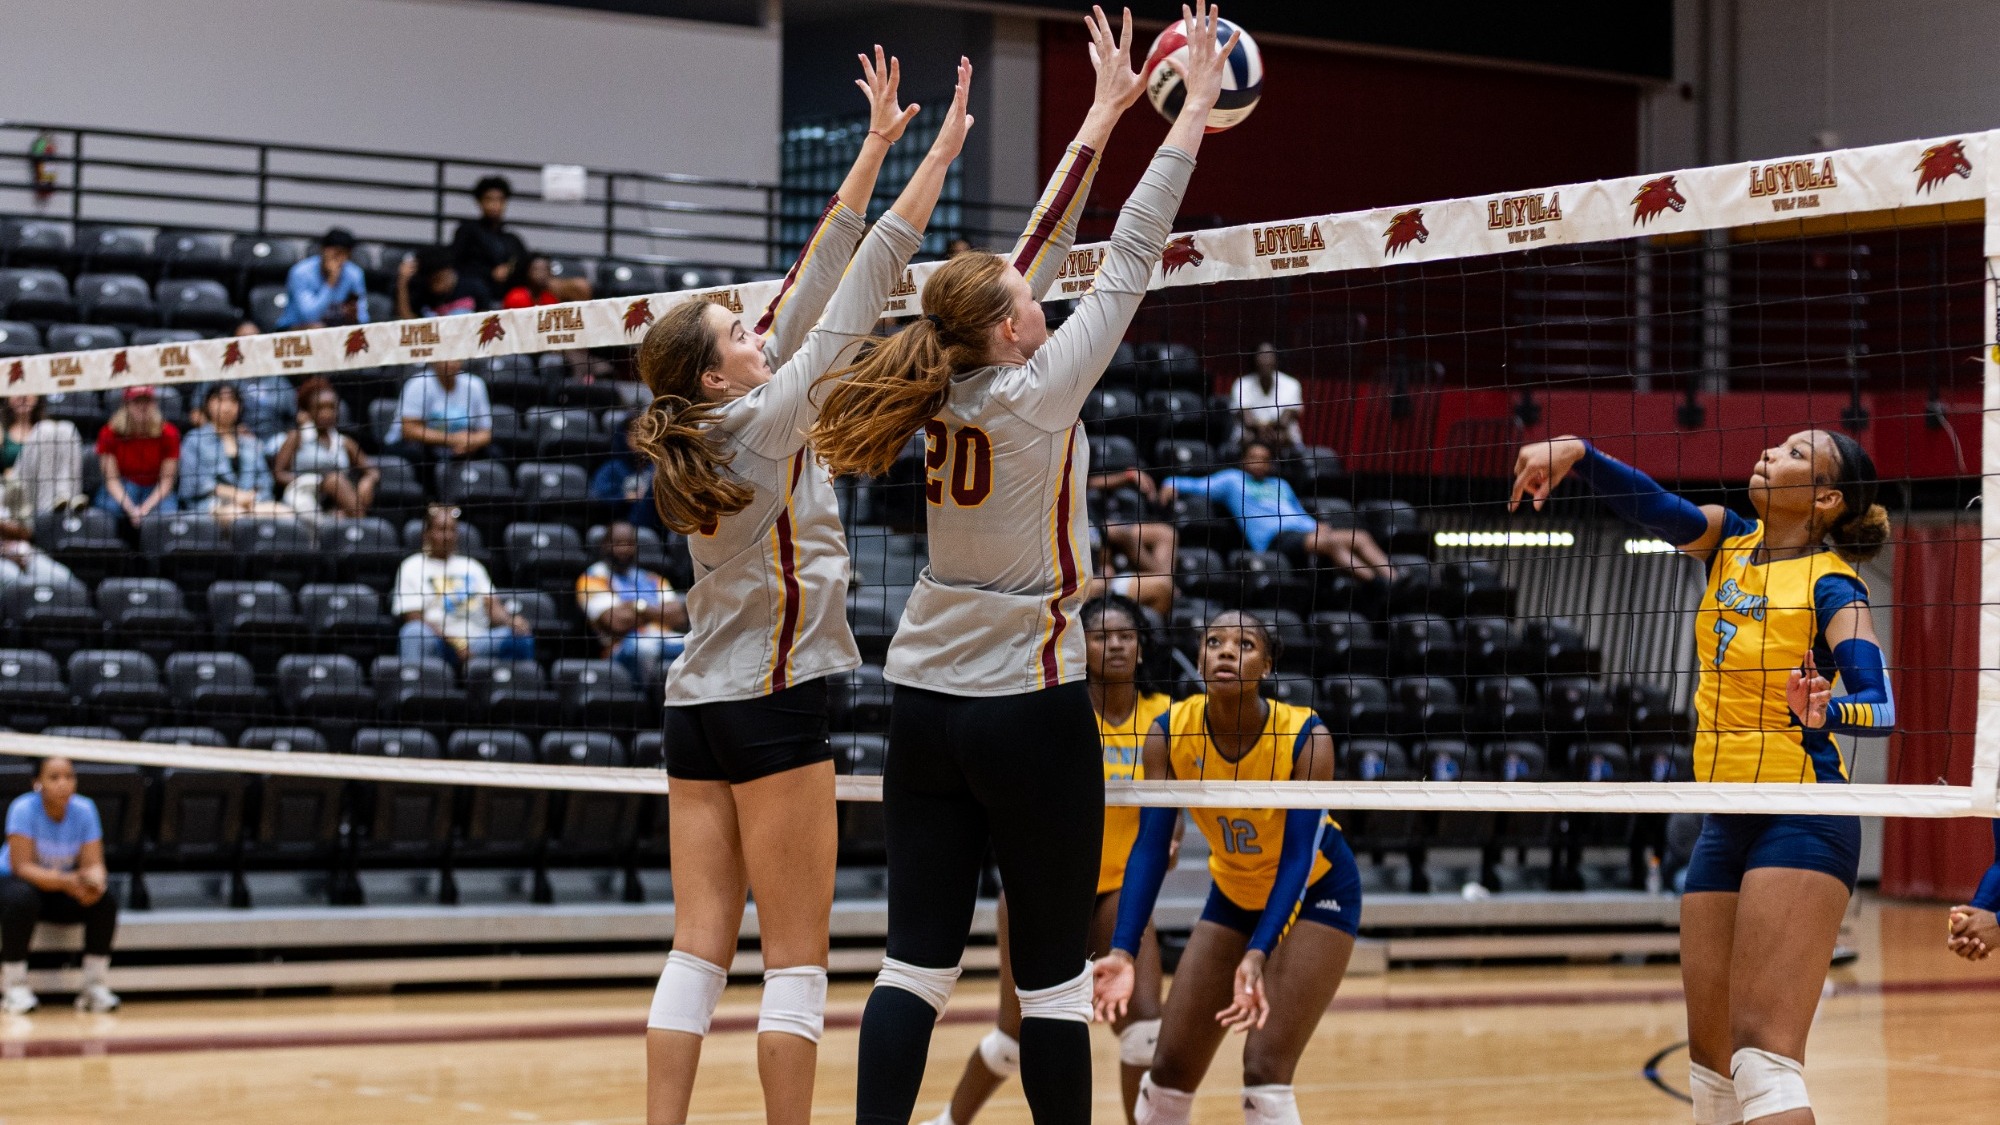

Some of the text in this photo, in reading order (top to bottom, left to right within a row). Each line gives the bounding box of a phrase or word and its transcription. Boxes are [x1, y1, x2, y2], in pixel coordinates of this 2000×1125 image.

[1749, 157, 1838, 198] LOYOLA
[1488, 192, 1562, 230] LOYOLA
[1253, 222, 1325, 256] LOYOLA
[537, 306, 584, 333] LOYOLA
[924, 418, 993, 509] 20
[1713, 618, 1737, 665] 7
[1217, 816, 1263, 854] 12
